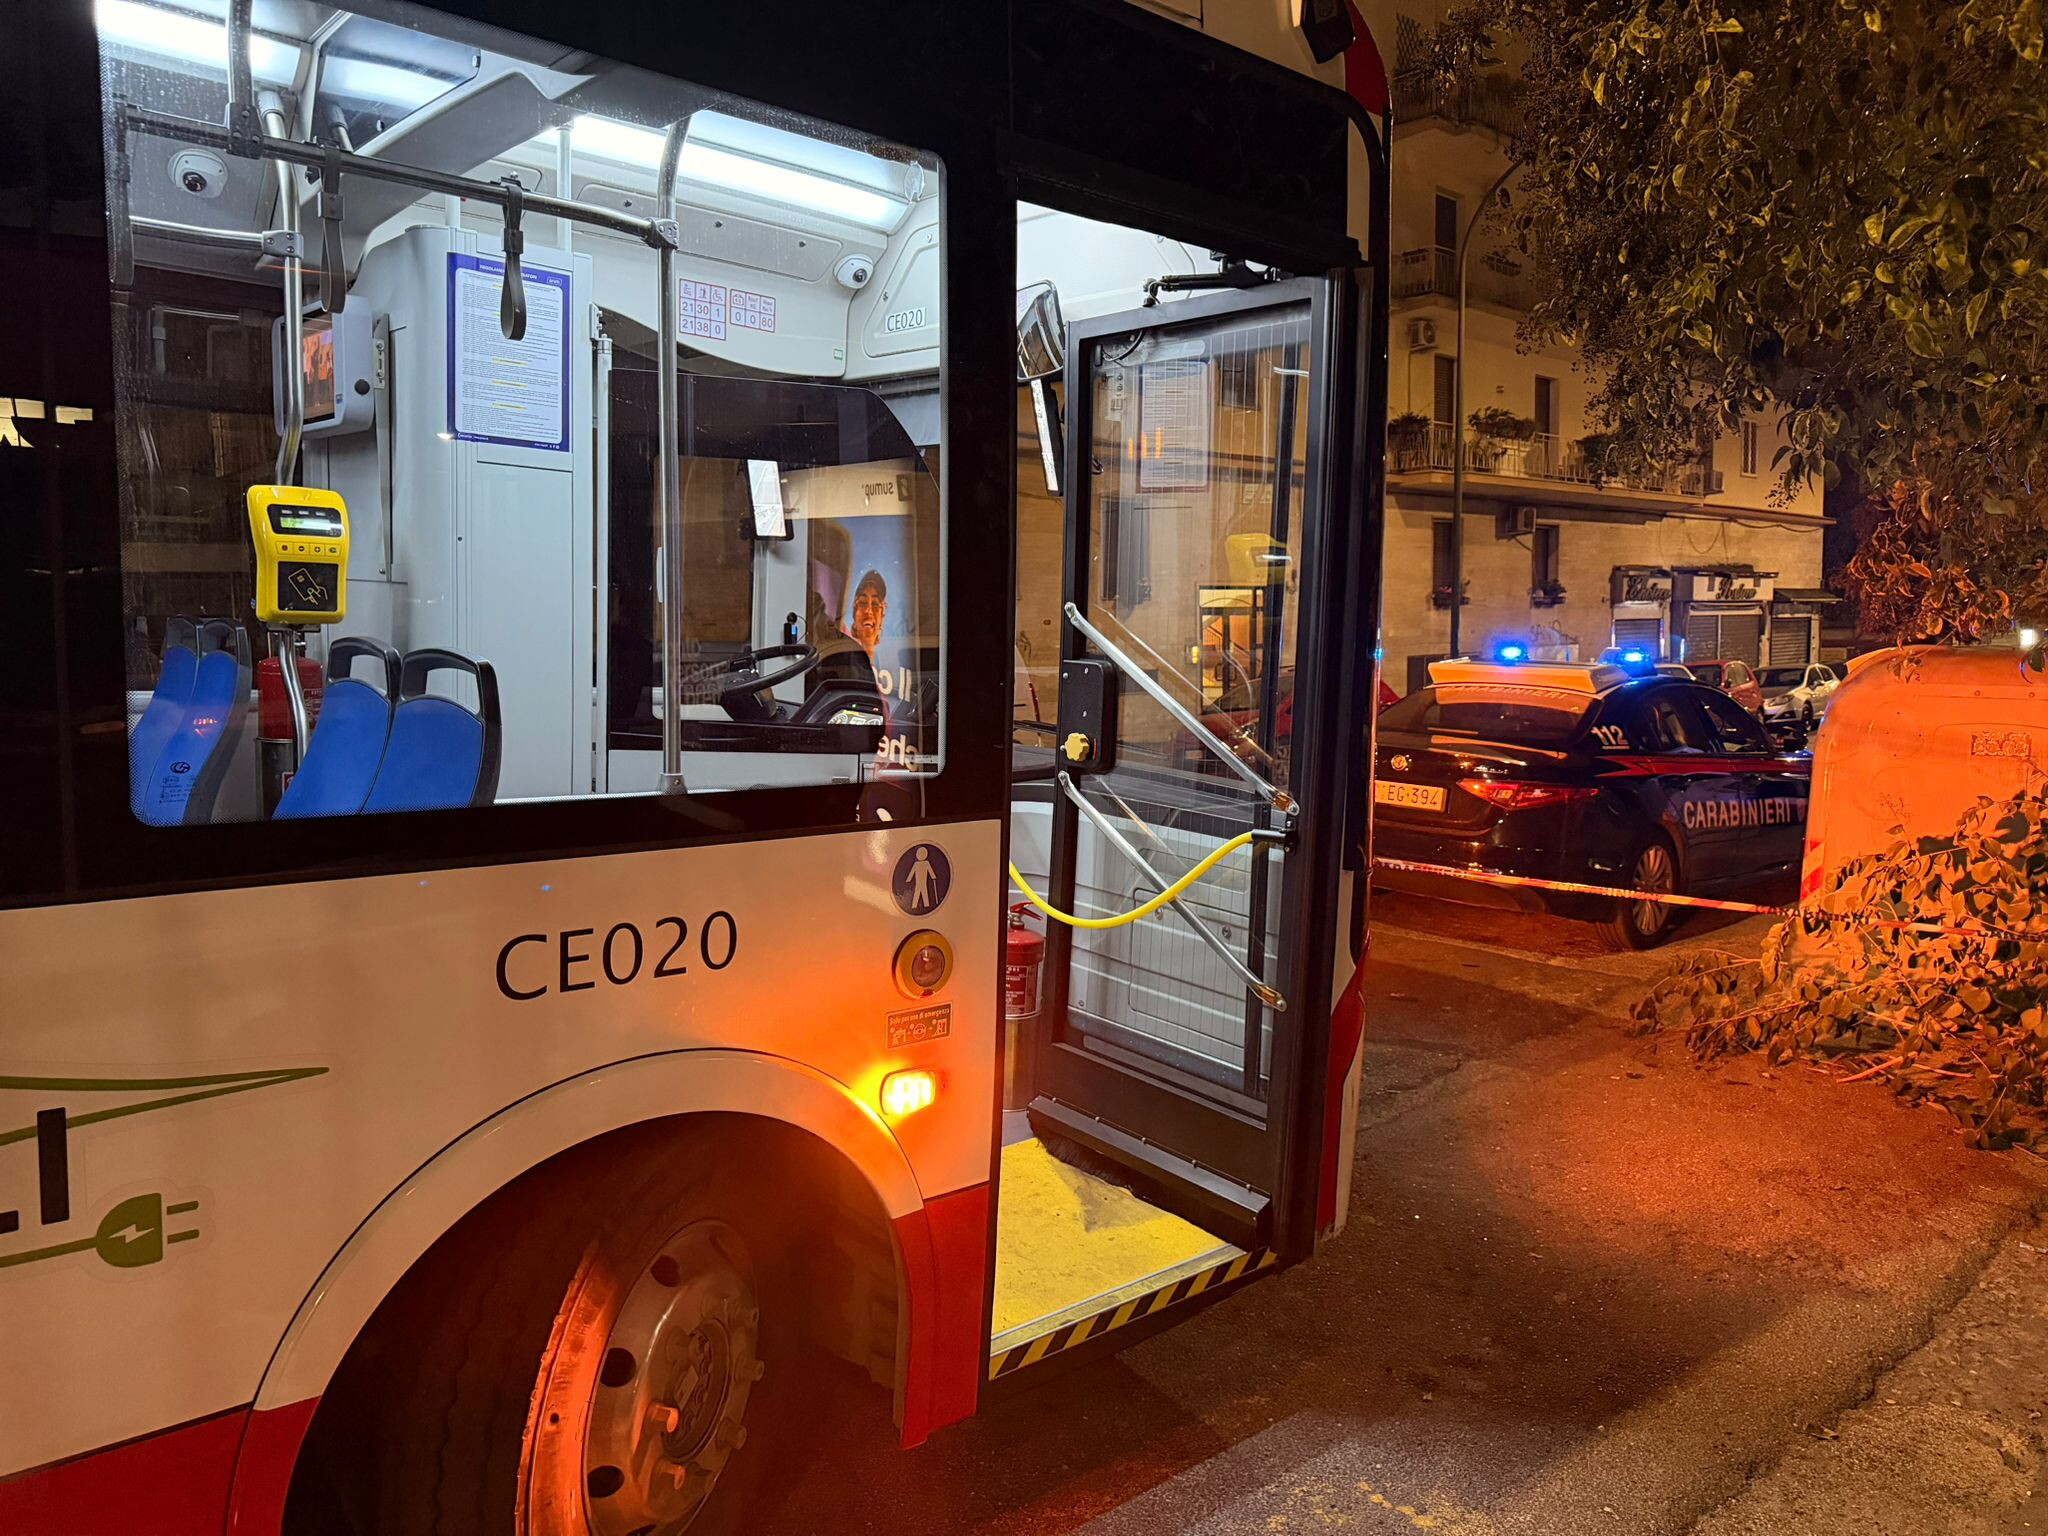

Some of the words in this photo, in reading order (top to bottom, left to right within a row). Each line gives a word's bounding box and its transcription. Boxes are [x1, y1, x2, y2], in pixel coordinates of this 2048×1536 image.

[682, 301, 693, 312] 21
[697, 304, 709, 315] 30
[682, 319, 693, 330] 21
[697, 322, 709, 333] 38
[715, 325, 721, 334] 0
[735, 312, 741, 321] 0
[750, 315, 756, 324] 0
[761, 317, 773, 328] 80
[886, 309, 923, 332] CE020
[1591, 725, 1630, 746] 112
[1683, 799, 1791, 829] CARABINIERI
[495, 910, 738, 1001] CE020
